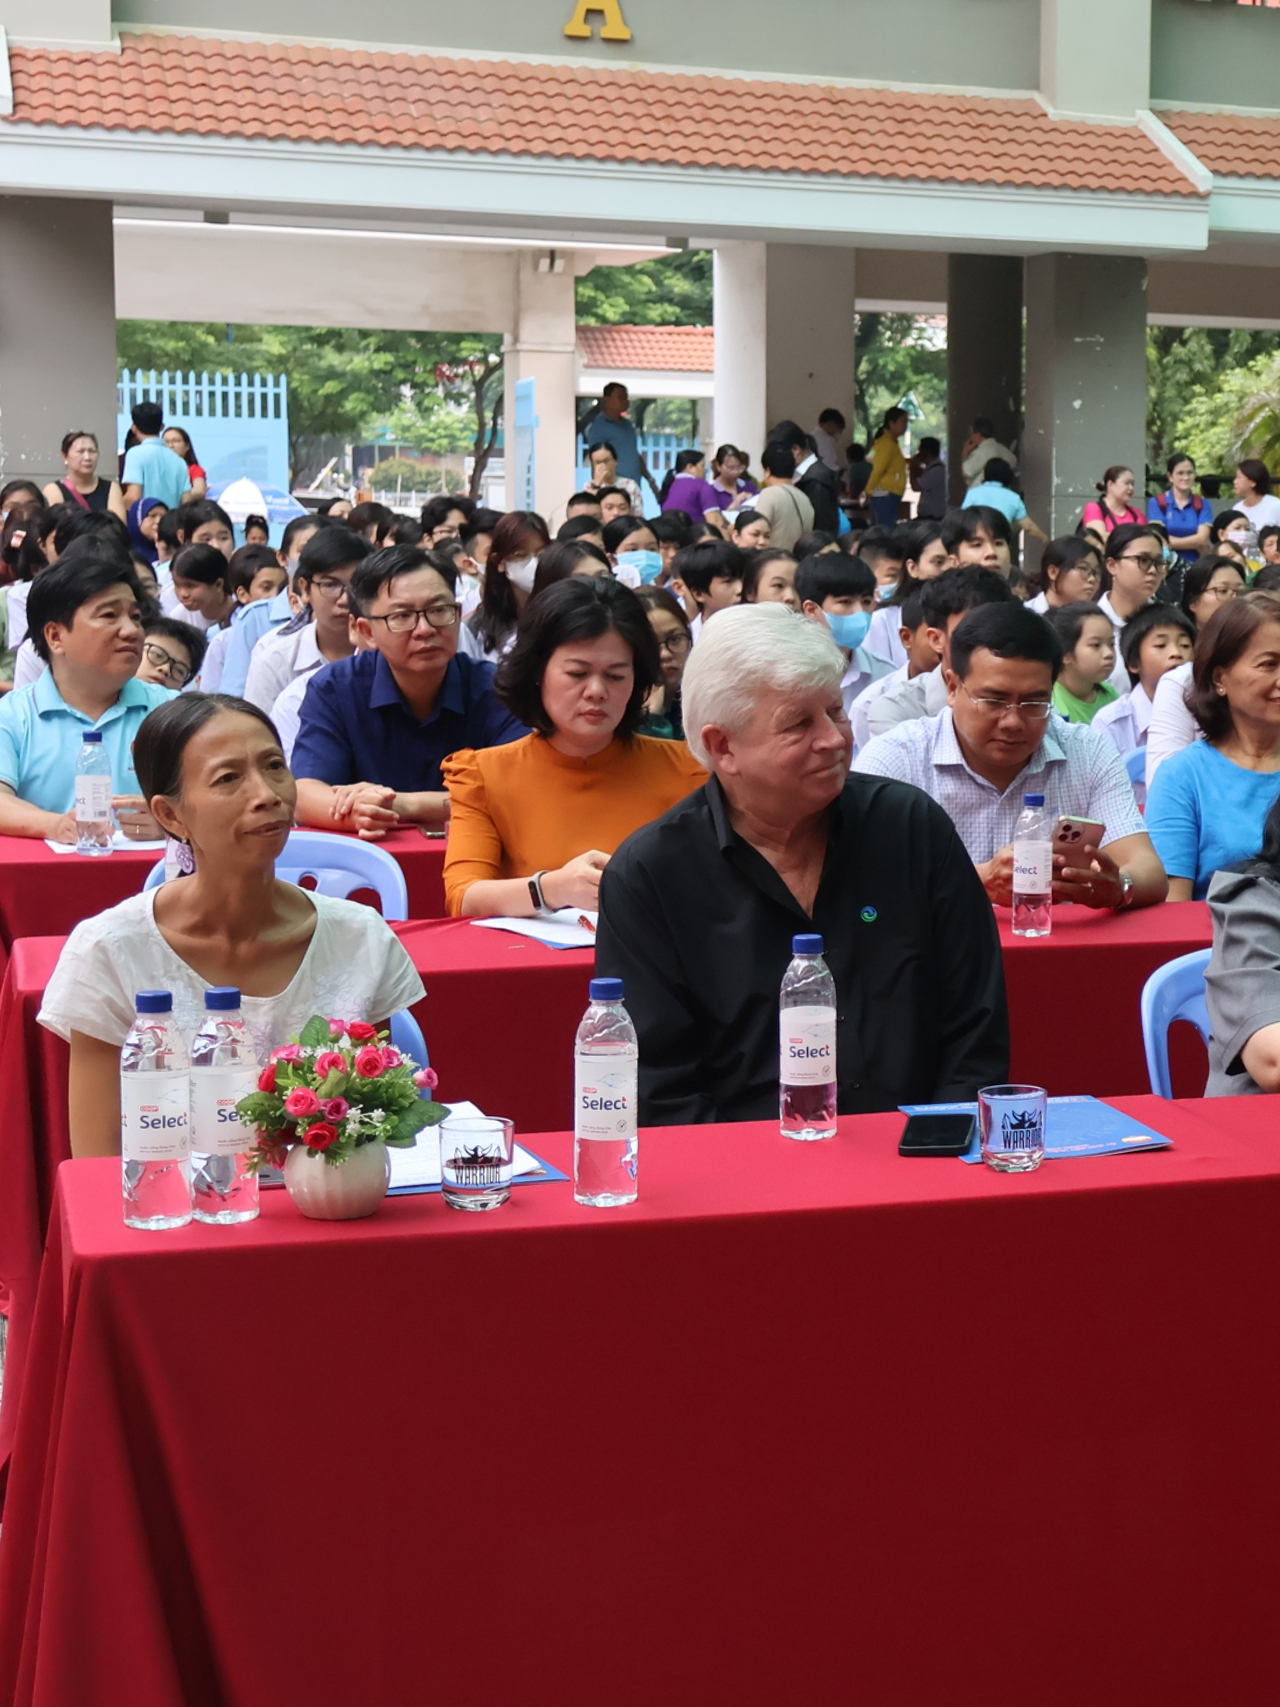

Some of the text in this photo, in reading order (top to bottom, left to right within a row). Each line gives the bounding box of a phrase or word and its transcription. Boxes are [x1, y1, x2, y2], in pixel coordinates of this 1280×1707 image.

[789, 1044, 830, 1059] Select
[582, 1095, 627, 1110] Select
[140, 1112, 188, 1129] Select
[1002, 1129, 1043, 1151] WARRIOR
[454, 1165, 501, 1187] WARRIOR
